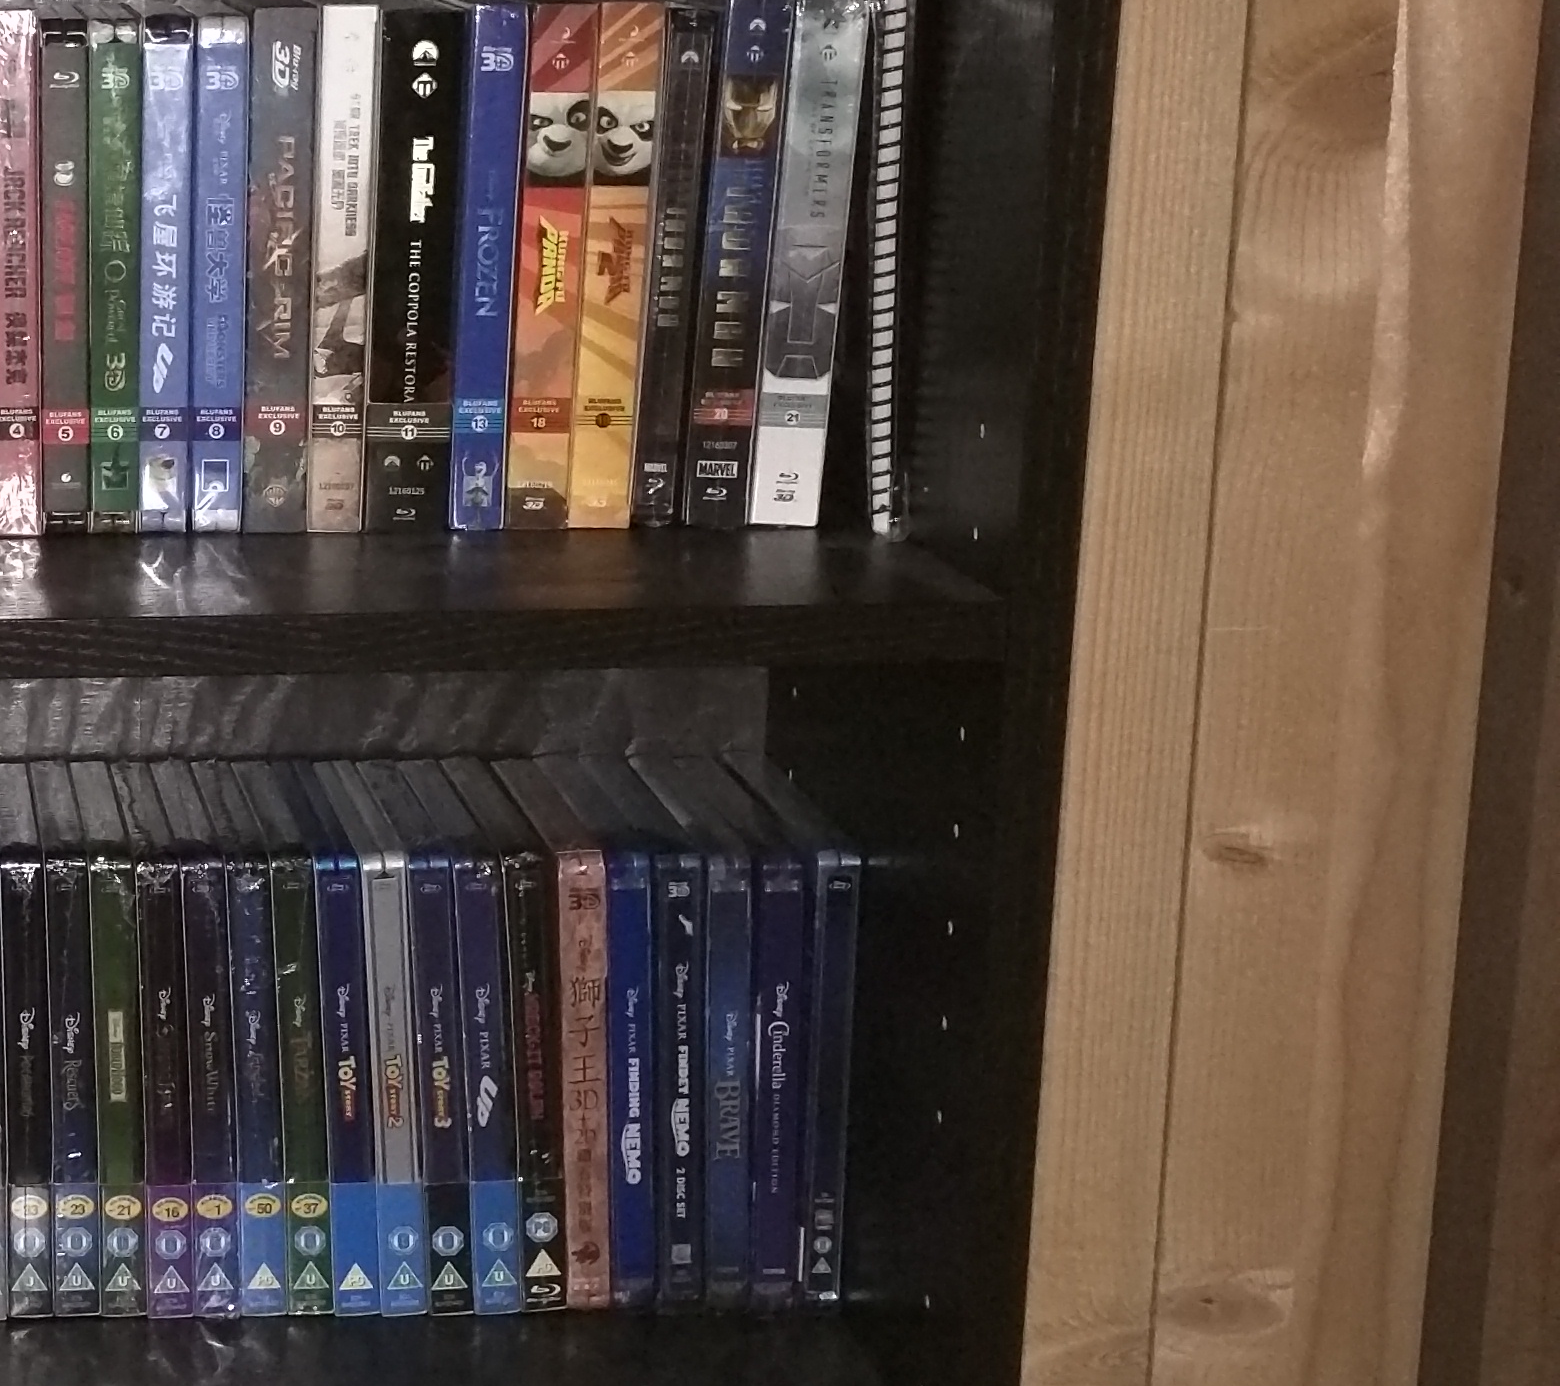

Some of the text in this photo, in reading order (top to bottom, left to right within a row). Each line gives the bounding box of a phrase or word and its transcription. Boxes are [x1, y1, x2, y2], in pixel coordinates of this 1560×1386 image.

[347, 124, 361, 151] TREK
[412, 136, 435, 162] The
[810, 79, 840, 218] TRANSFORMERS
[150, 194, 178, 339] 飞屋环游记
[206, 198, 235, 304] 怪兽大学
[273, 135, 297, 360] PACIFIC RIM
[475, 208, 504, 318] FROZEN
[535, 215, 559, 316] PANDA
[405, 240, 423, 337] THE COPPOLA
[698, 463, 737, 478] MARVEL
[16, 1007, 35, 1050] Disney
[62, 1012, 81, 1054] Disney
[676, 1003, 689, 1041] PIXAR
[336, 1022, 357, 1118] PIXAR TOY STORY
[384, 1054, 403, 1088] TOY
[432, 1055, 451, 1089] TOY
[479, 1030, 491, 1070] PIXAR
[677, 1044, 690, 1096] FINDET
[768, 1020, 791, 1090] Cinderella
[620, 1057, 643, 1185] FINDING NEMO
[670, 1097, 691, 1157] NEMO
[713, 1077, 742, 1160] BRAVE
[771, 1092, 782, 1145] DIAMOND
[675, 1176, 687, 1200] DISC
[770, 1147, 782, 1194] EDITION
[675, 1202, 687, 1219] SET
